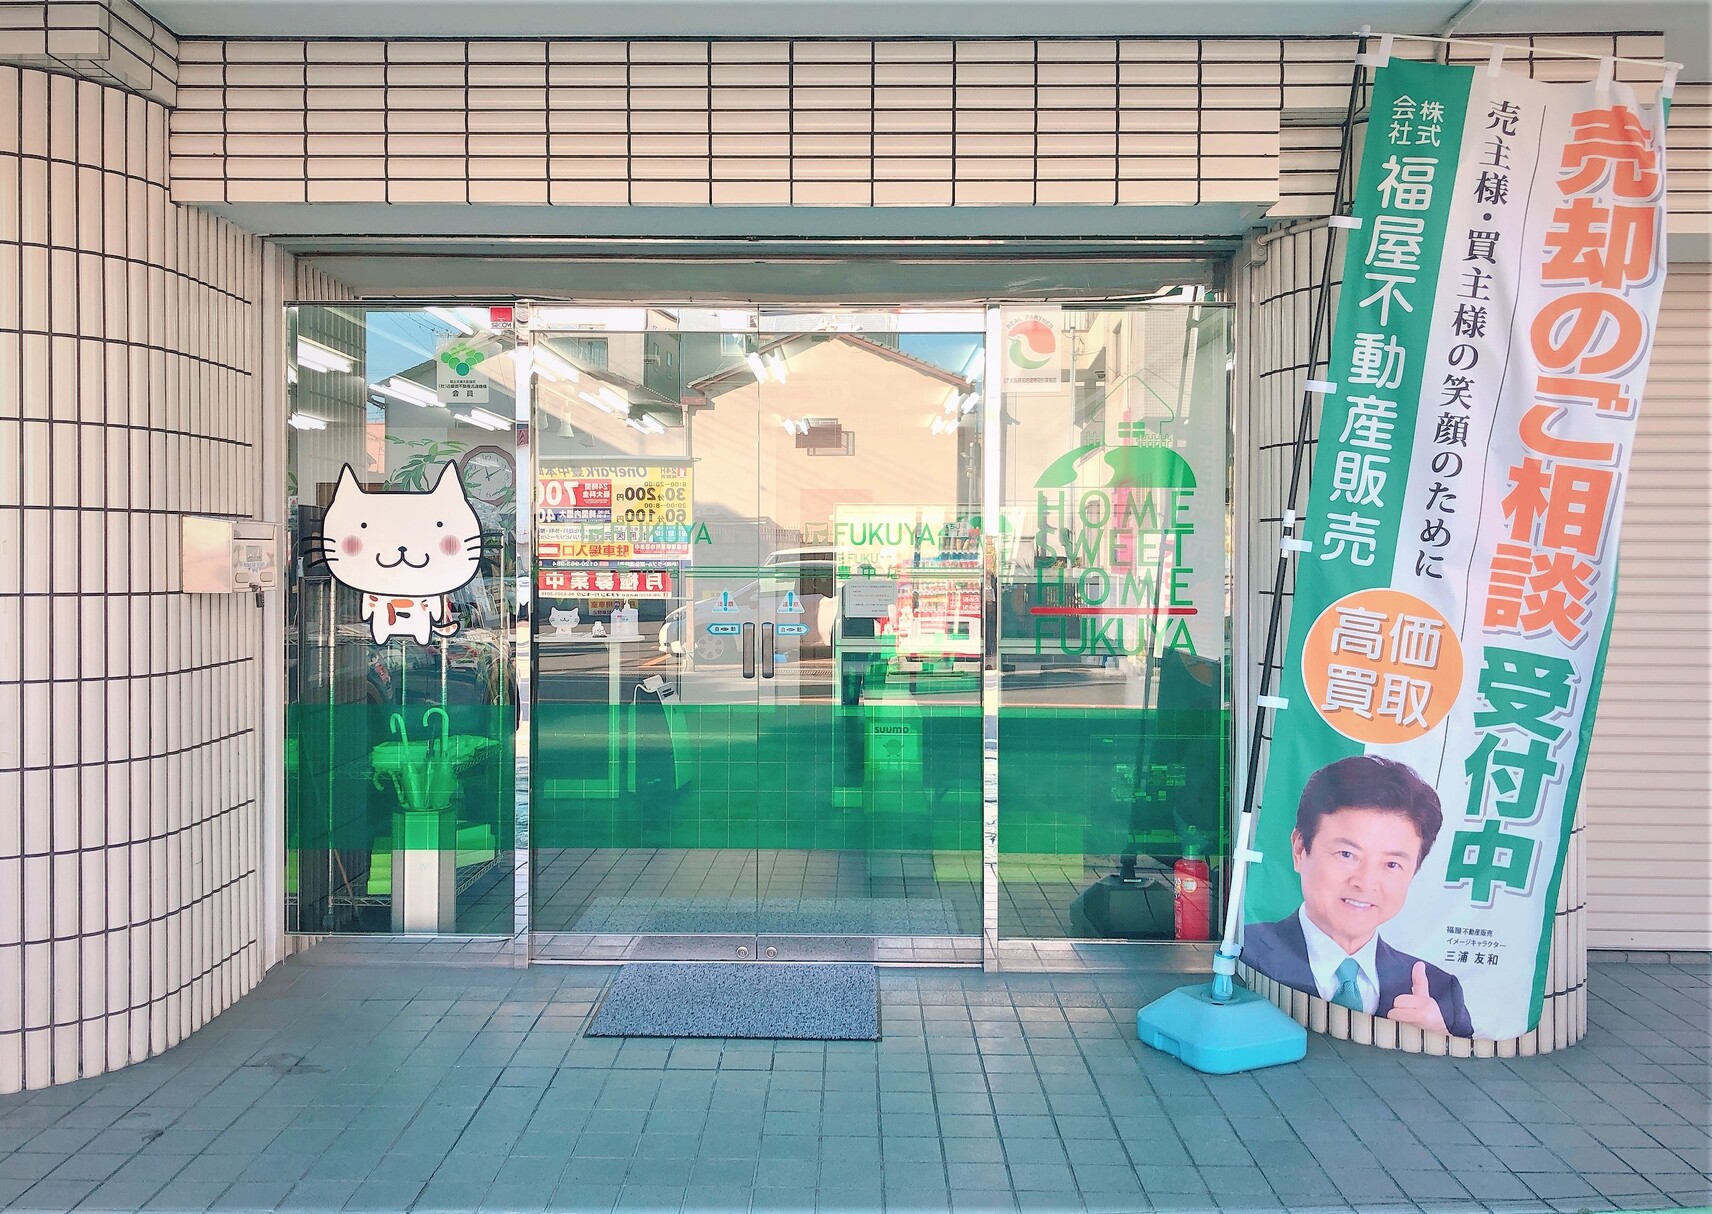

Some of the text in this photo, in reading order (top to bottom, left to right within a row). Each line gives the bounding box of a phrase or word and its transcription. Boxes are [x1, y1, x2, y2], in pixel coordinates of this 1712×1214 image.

[1415, 101, 1521, 579] 売主様・買主様の笑顔のために
[1319, 155, 1439, 567] 福屋不動産販売
[1037, 490, 1195, 529] HOME
[834, 522, 935, 546] FUKUYA
[1035, 528, 1195, 567] SWEET
[1036, 567, 1194, 606] HOME
[1035, 617, 1198, 657] FUKUYA
[1446, 926, 1493, 938] 福屋不動産販売
[1446, 937, 1507, 949] イメージキャラクター
